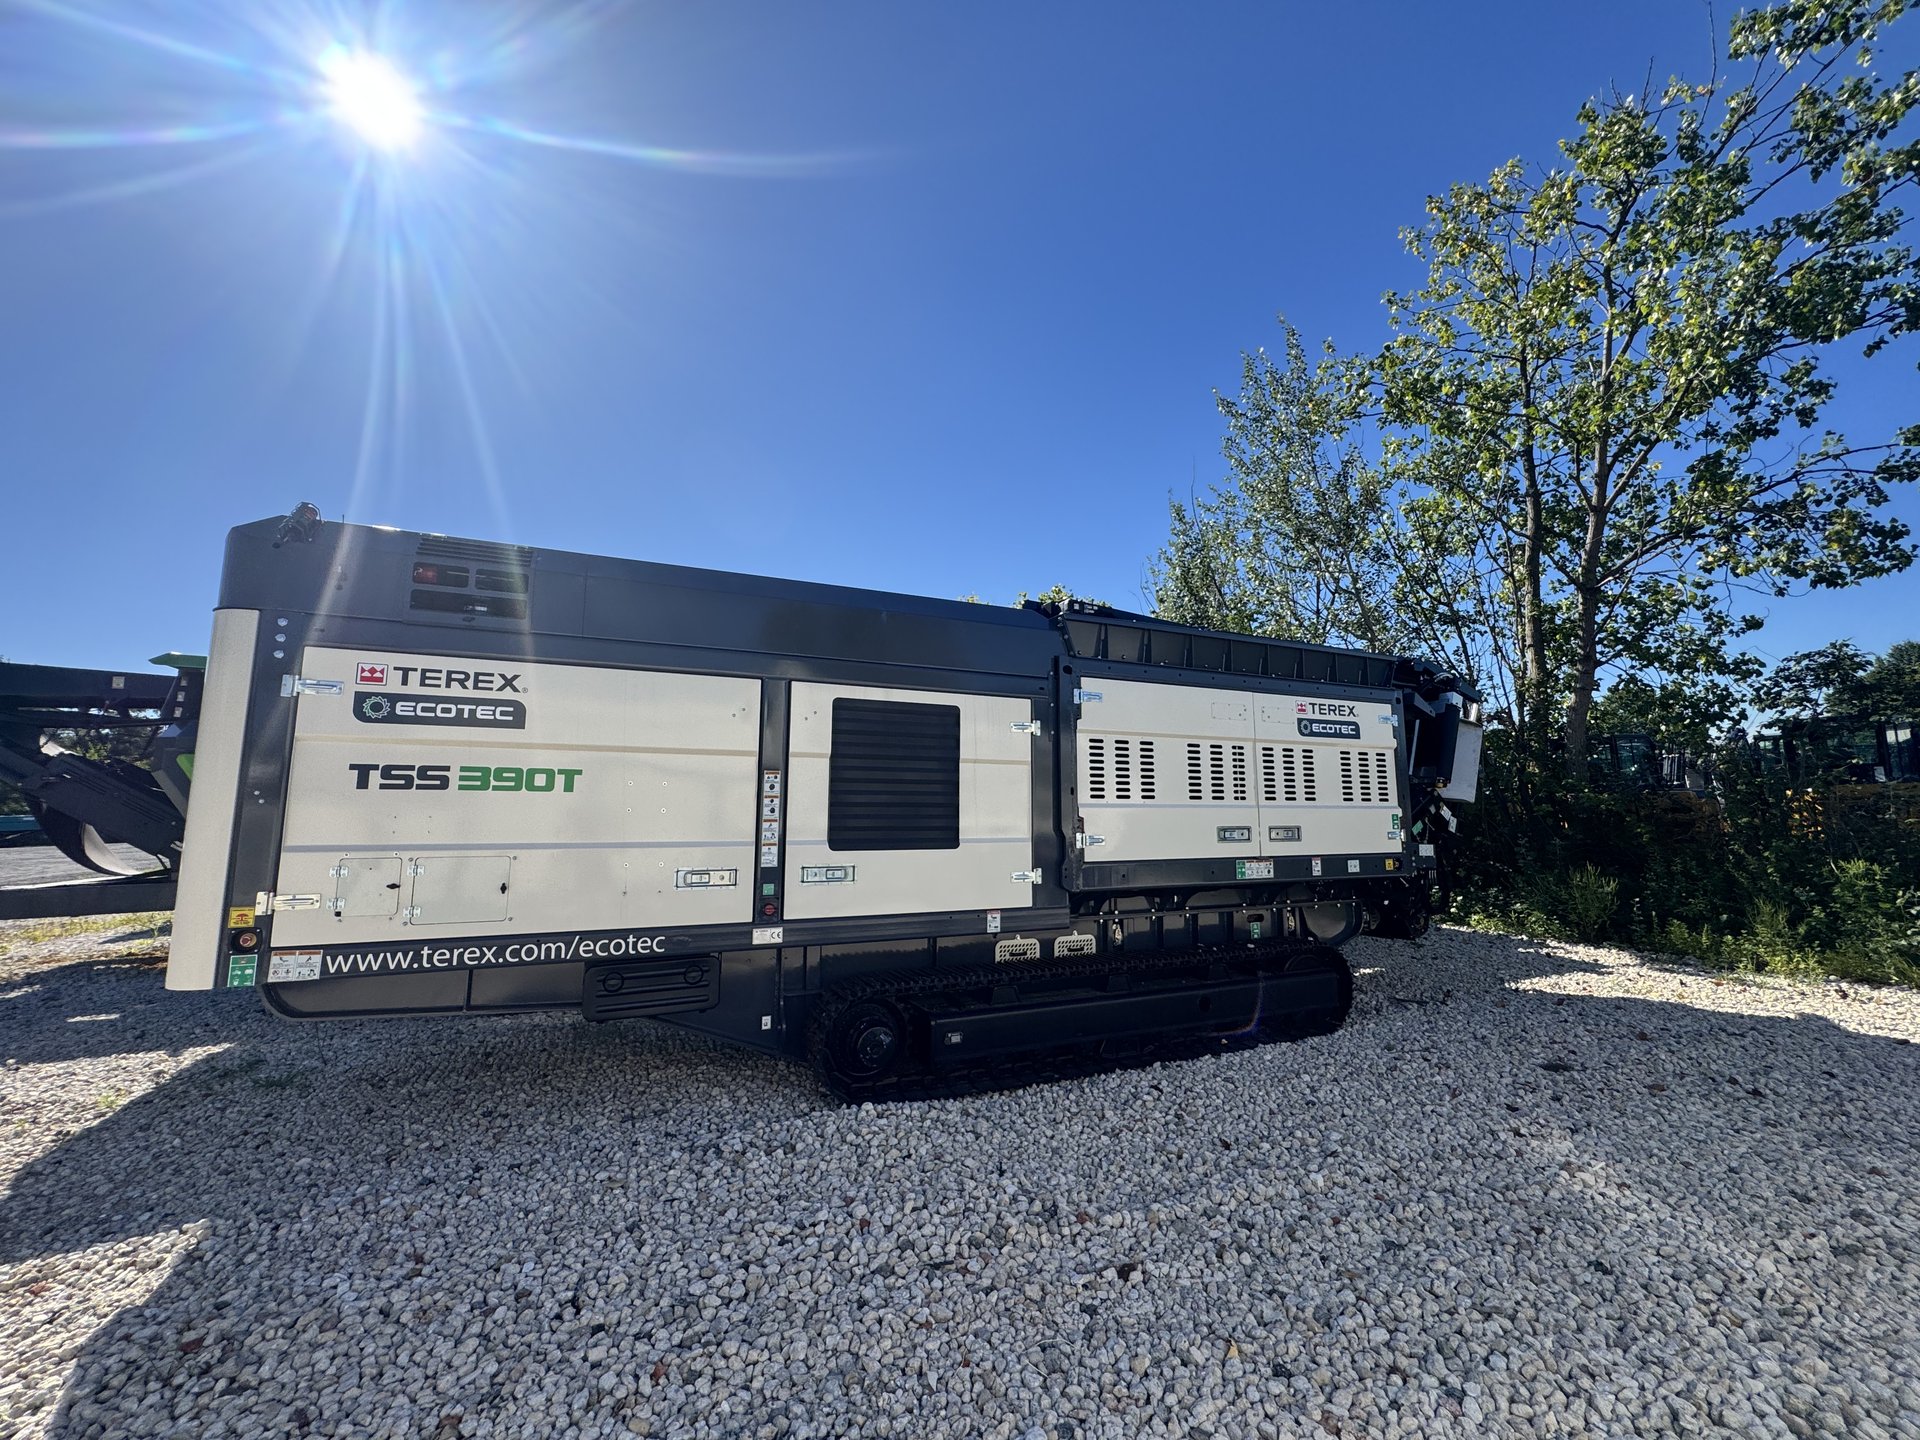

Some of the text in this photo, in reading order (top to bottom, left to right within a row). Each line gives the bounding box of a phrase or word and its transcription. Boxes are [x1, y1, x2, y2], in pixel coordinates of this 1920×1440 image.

[395, 701, 514, 721] ECOTEC
[1311, 723, 1356, 734] ECOTEC
[349, 763, 583, 793] TSS 390T
[326, 934, 666, 974] www.terex.com/ecotec
